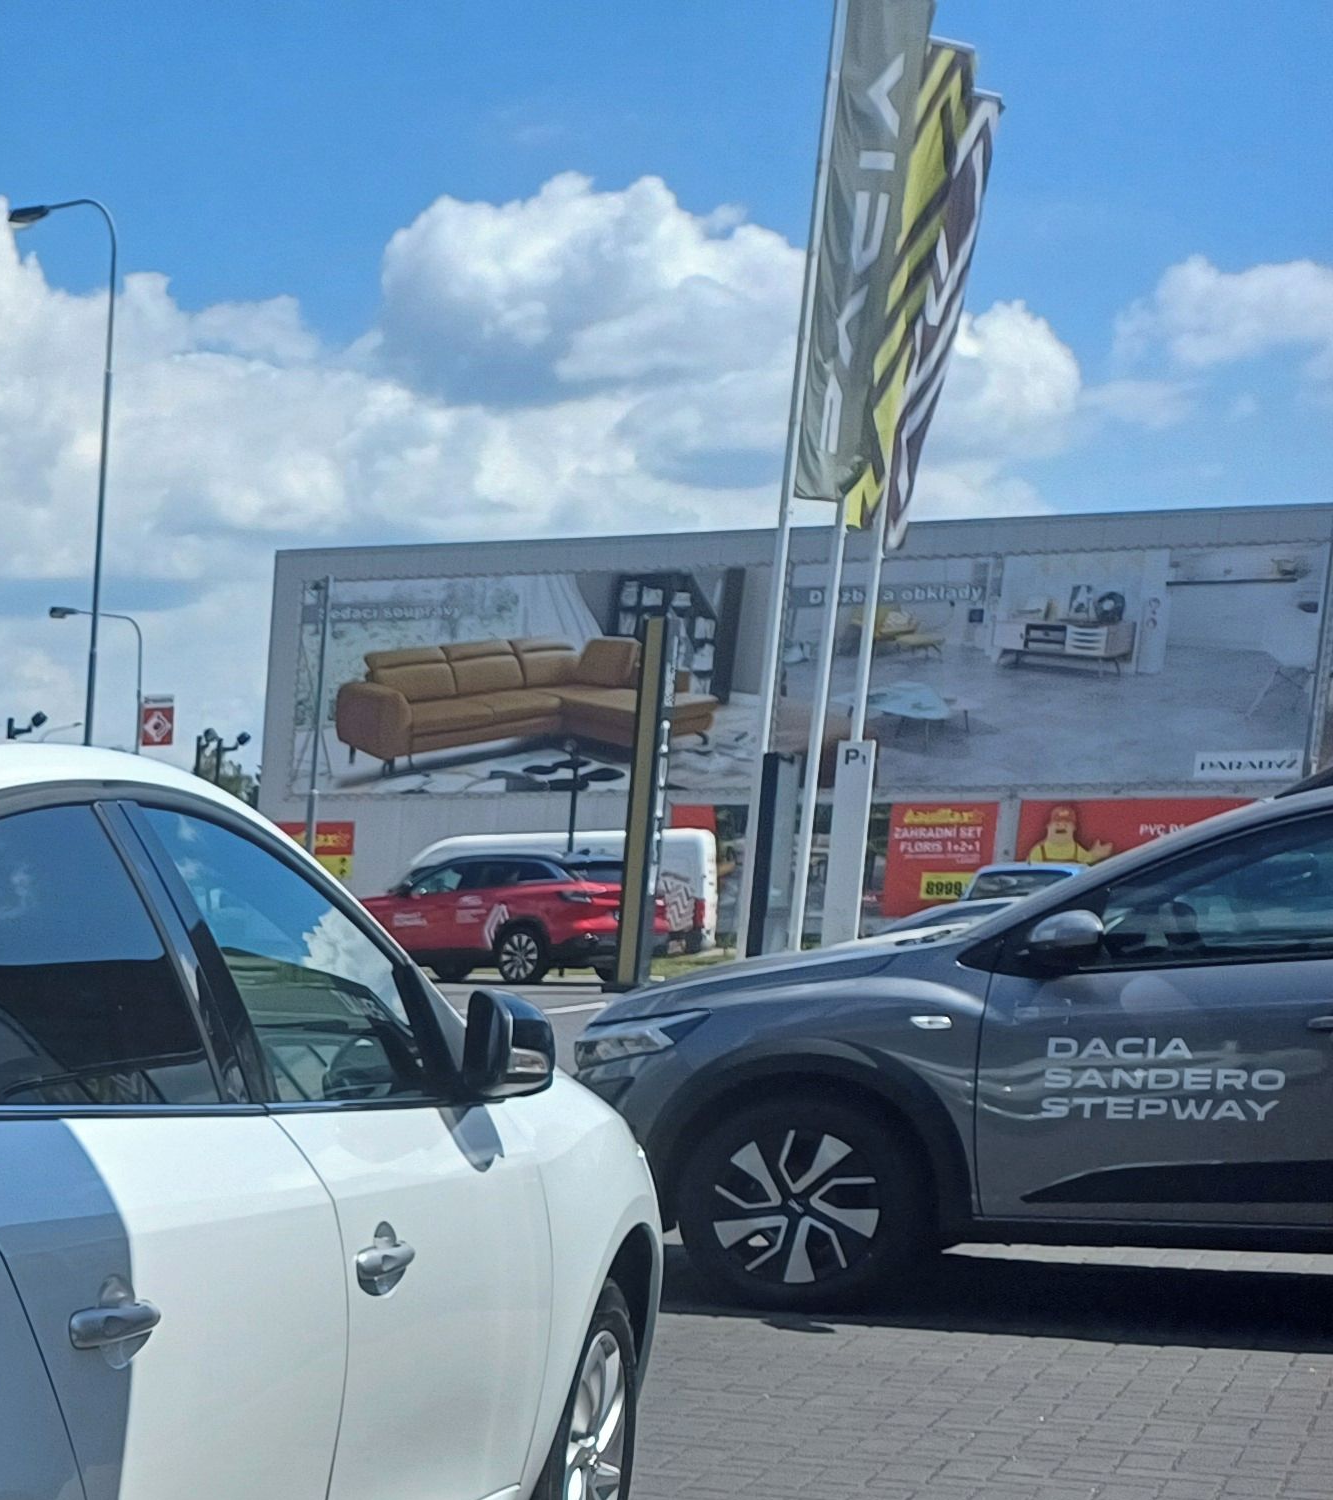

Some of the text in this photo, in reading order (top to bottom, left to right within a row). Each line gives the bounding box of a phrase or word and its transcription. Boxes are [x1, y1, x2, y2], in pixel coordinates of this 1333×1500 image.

[901, 584, 983, 602] obklady
[893, 825, 983, 839] ZAHRADNÍ SET
[1047, 1037, 1193, 1060] DACIA
[1044, 1067, 1286, 1092] SANDERO
[1040, 1097, 1280, 1122] STEPWAY
